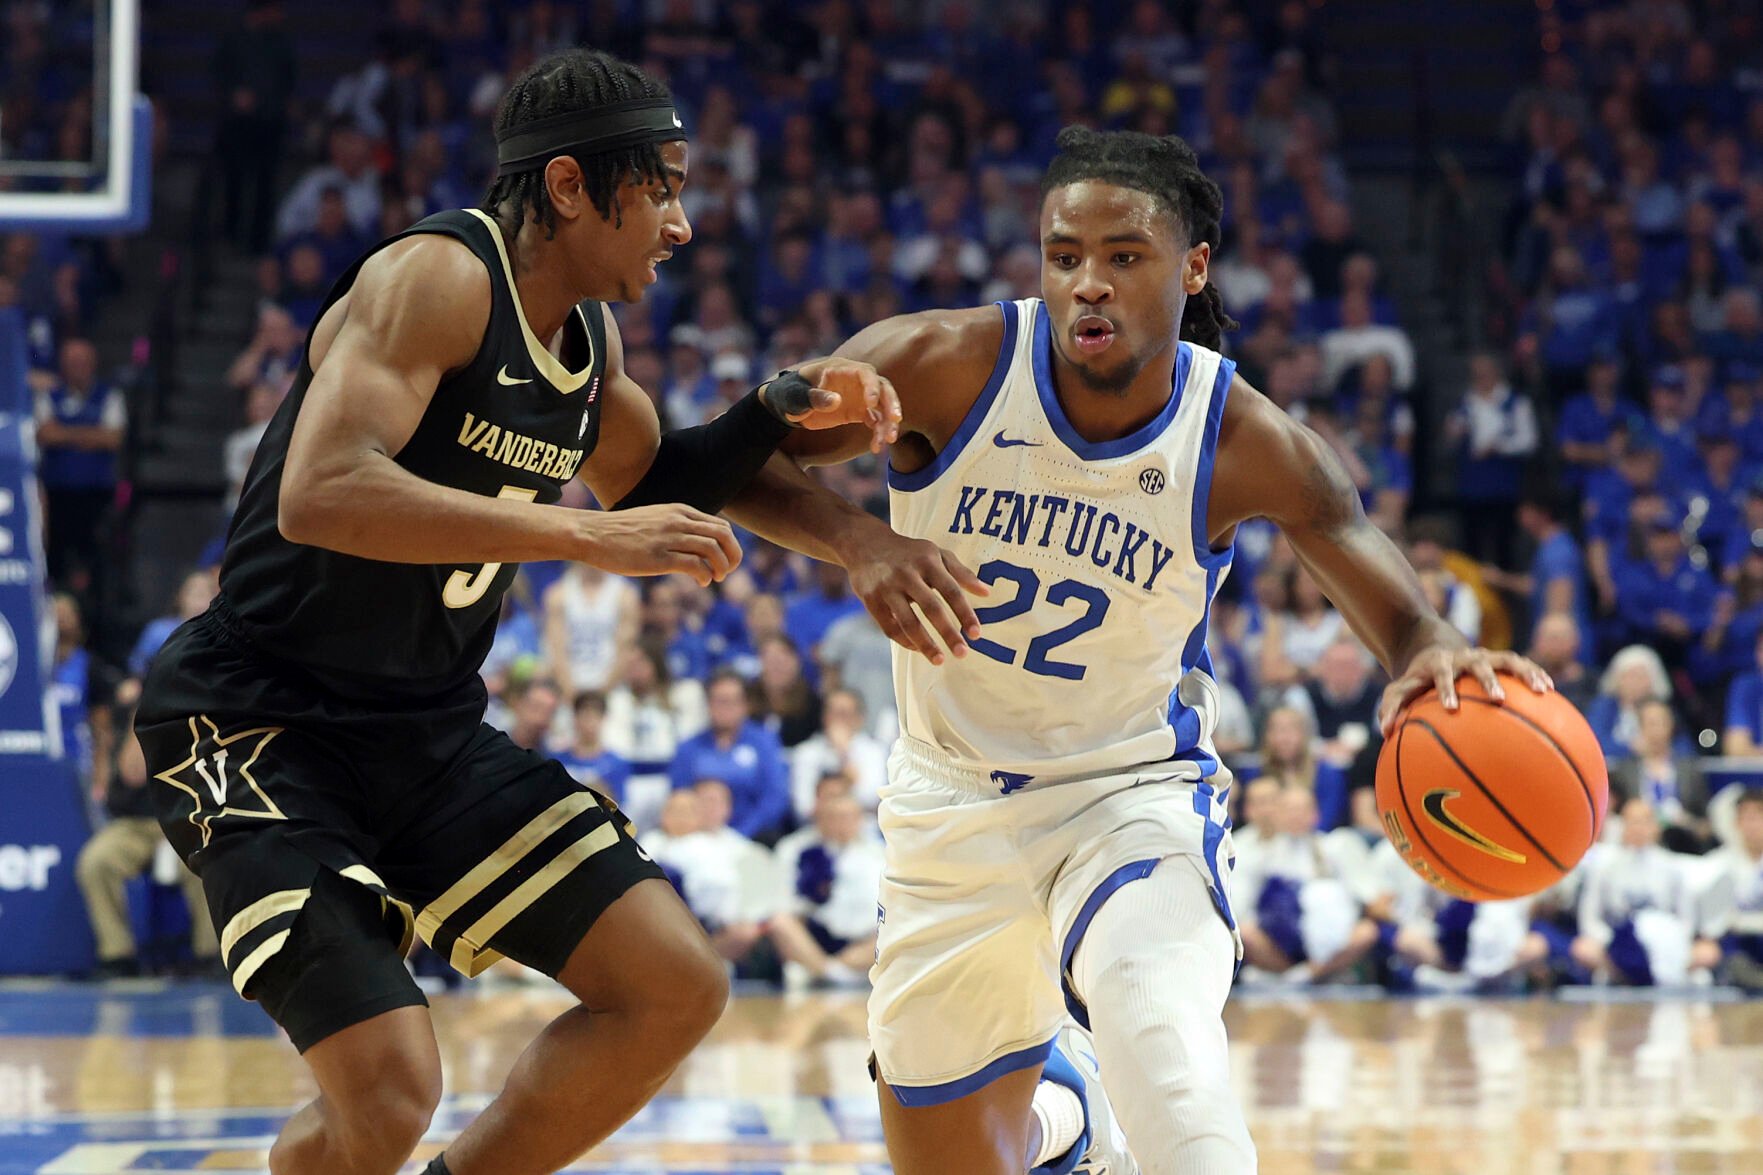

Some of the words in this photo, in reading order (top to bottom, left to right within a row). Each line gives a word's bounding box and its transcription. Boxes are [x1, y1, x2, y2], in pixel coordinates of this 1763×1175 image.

[1139, 468, 1165, 494] SEC
[949, 486, 1174, 591] KENTUCKY
[961, 559, 1111, 681] 22
[195, 748, 229, 806] V
